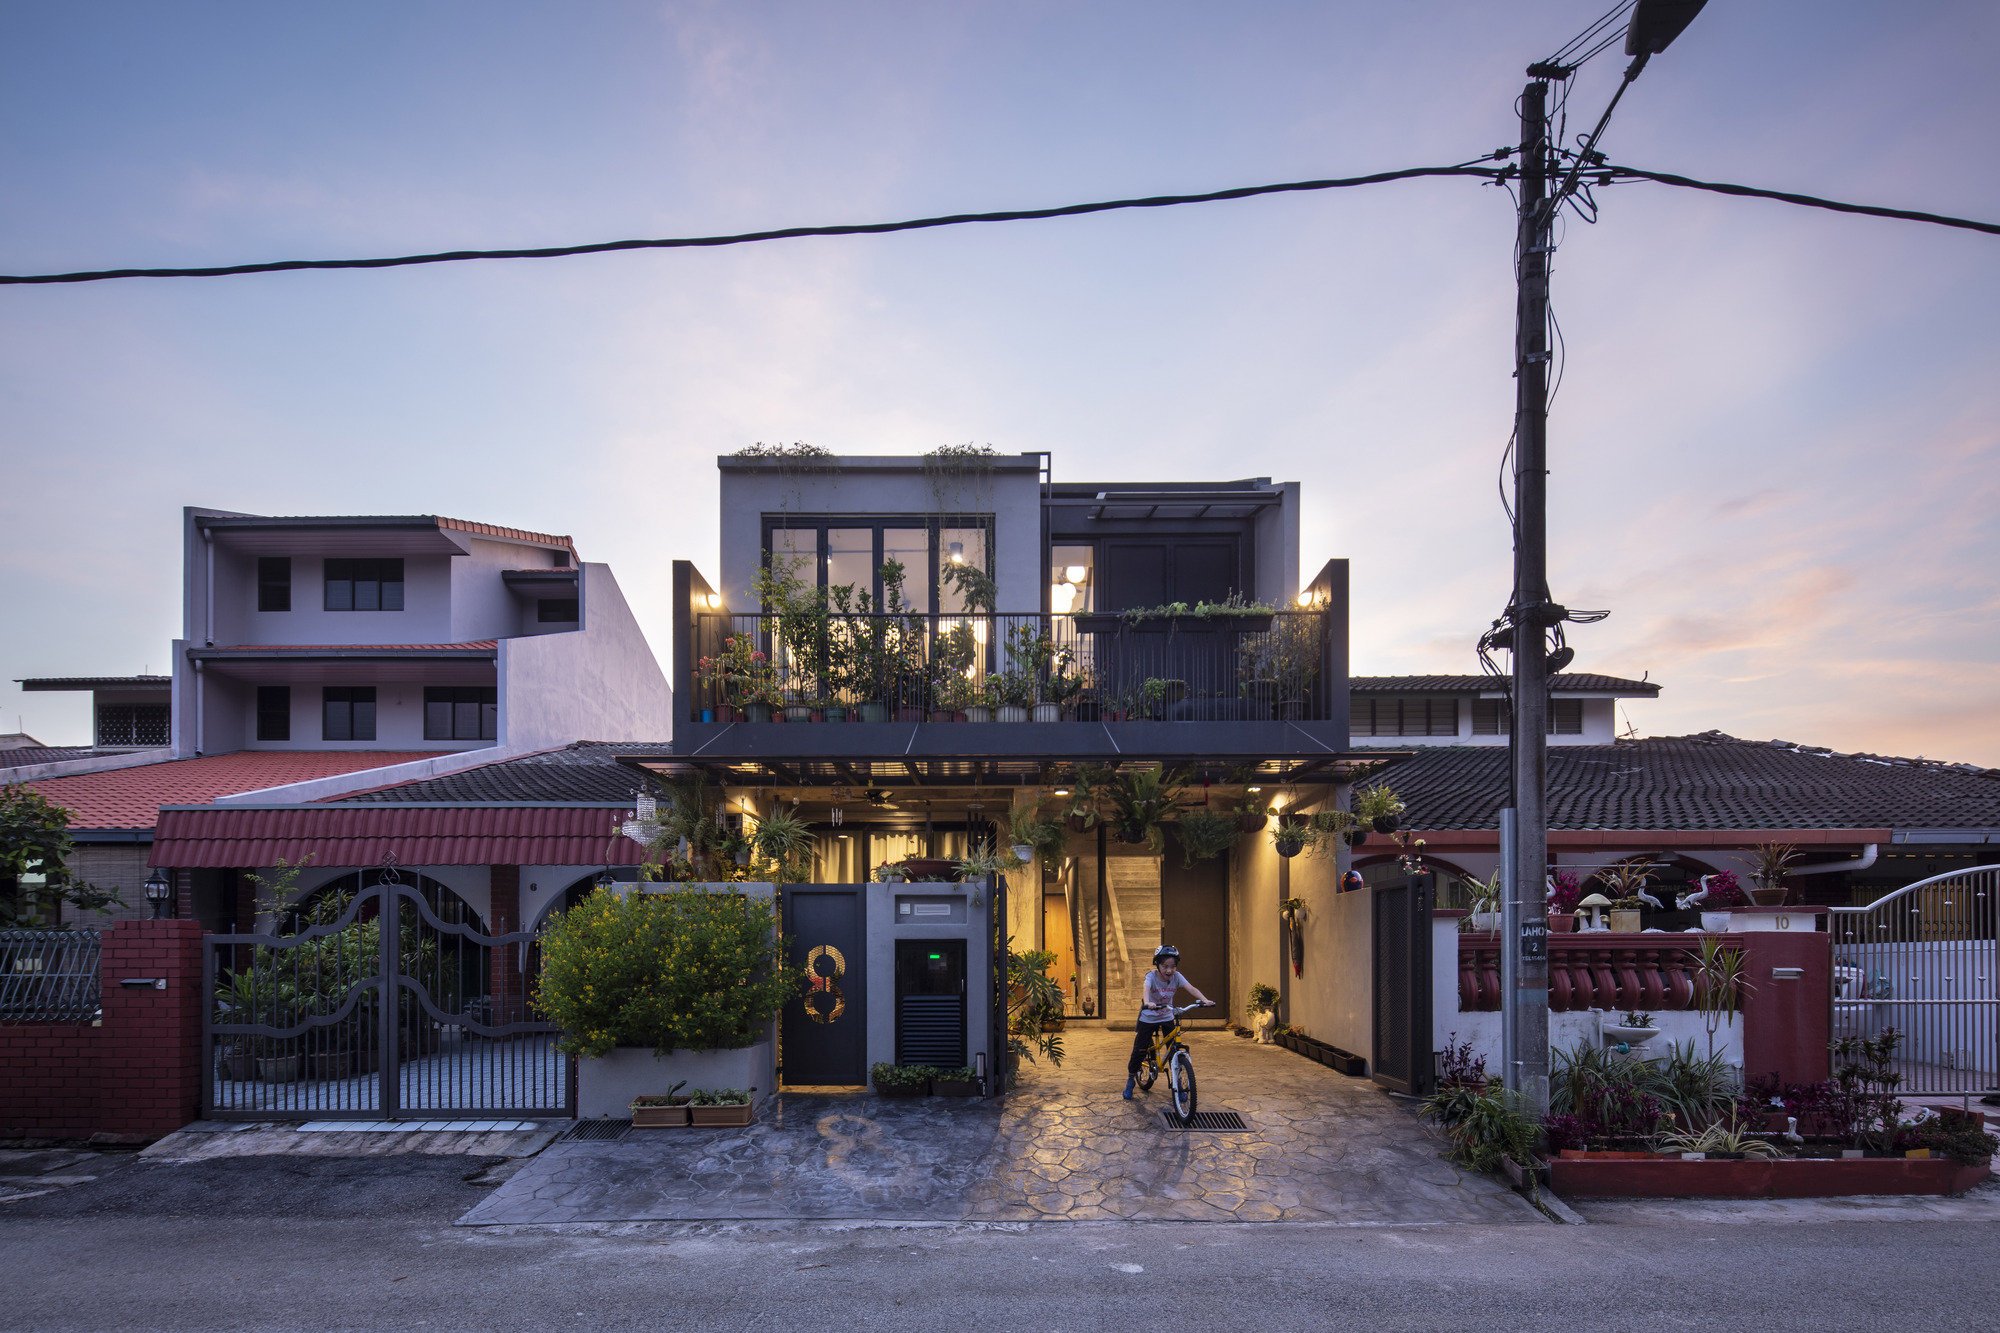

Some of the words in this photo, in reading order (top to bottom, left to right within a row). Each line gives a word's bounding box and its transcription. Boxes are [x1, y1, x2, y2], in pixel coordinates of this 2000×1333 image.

[1775, 915, 1790, 930] 10
[1532, 942, 1538, 952] 2
[803, 944, 846, 1024] 8
